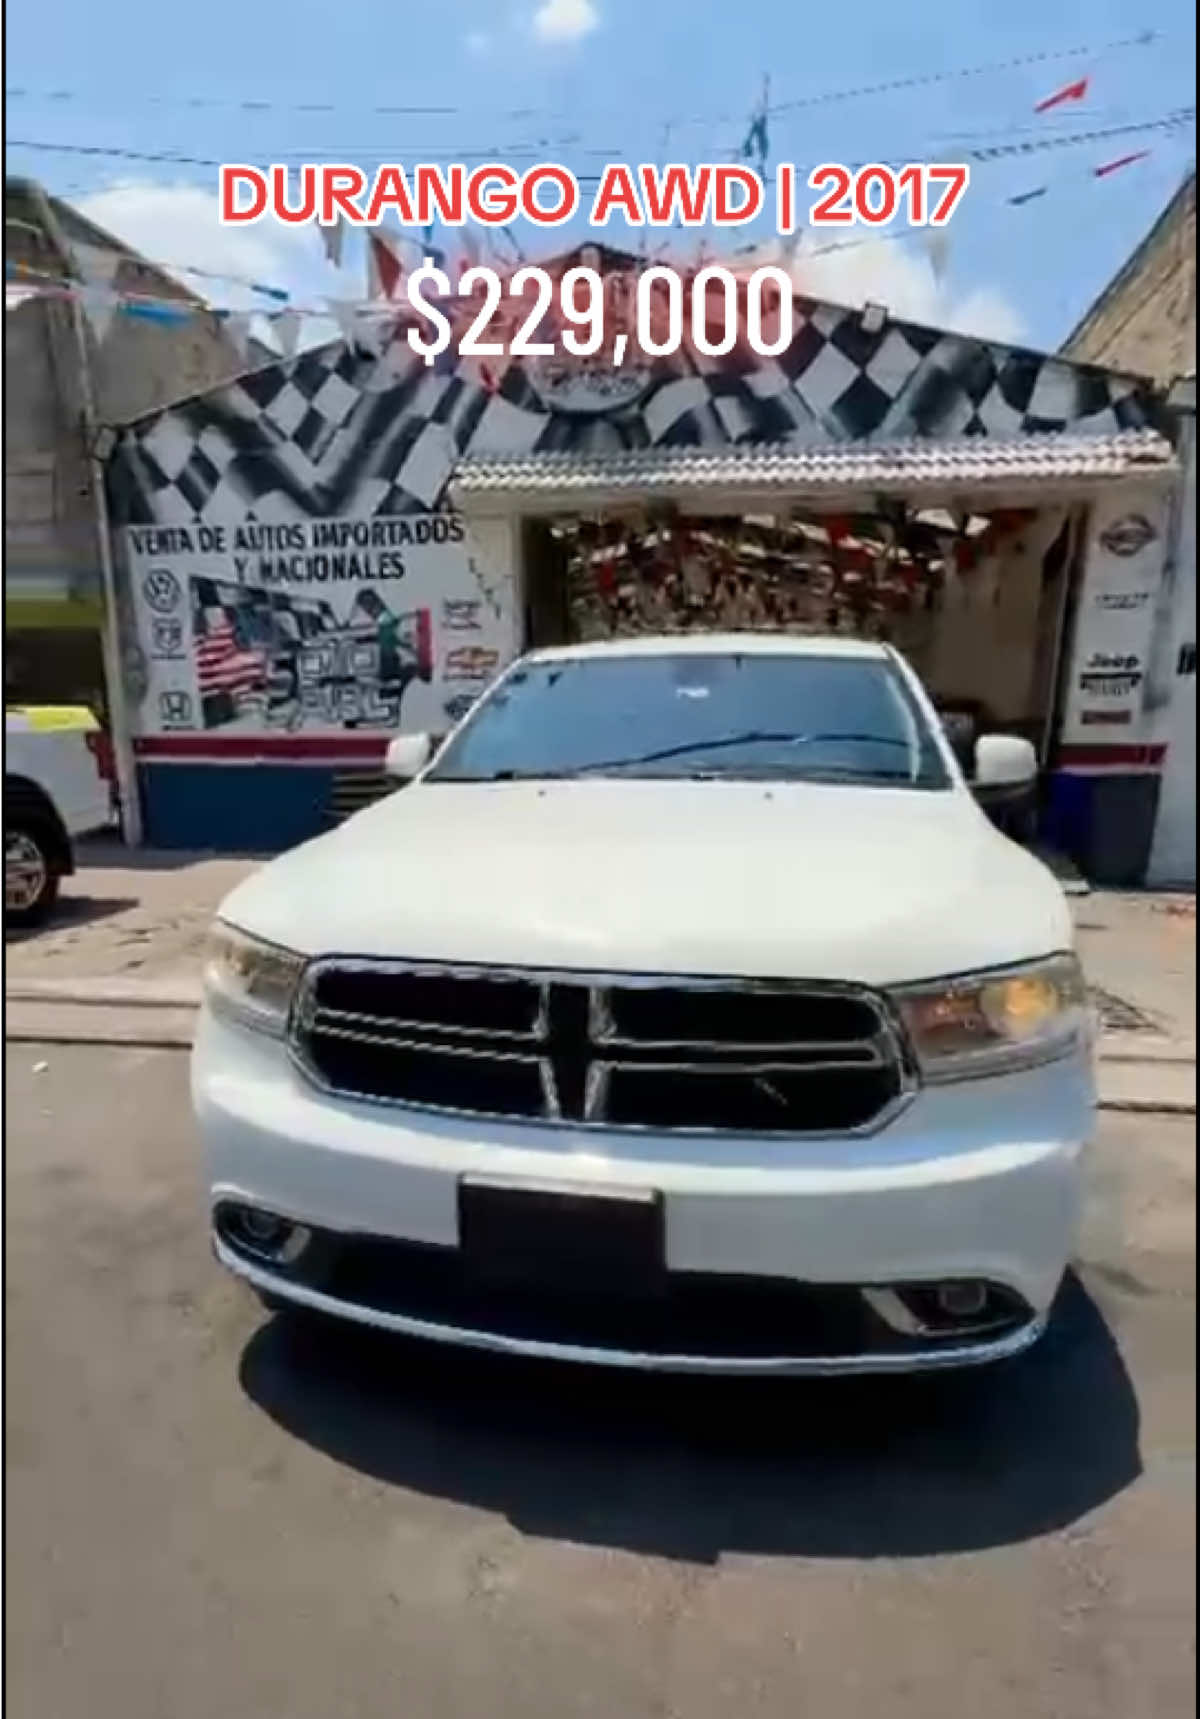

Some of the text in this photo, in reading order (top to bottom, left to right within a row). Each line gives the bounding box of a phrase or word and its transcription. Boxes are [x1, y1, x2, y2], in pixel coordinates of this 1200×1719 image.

[199, 526, 226, 553] DE
[235, 523, 306, 551] AUTOS
[312, 517, 465, 548] IMPORTADOS
[233, 553, 405, 583] Y NACIONALES
